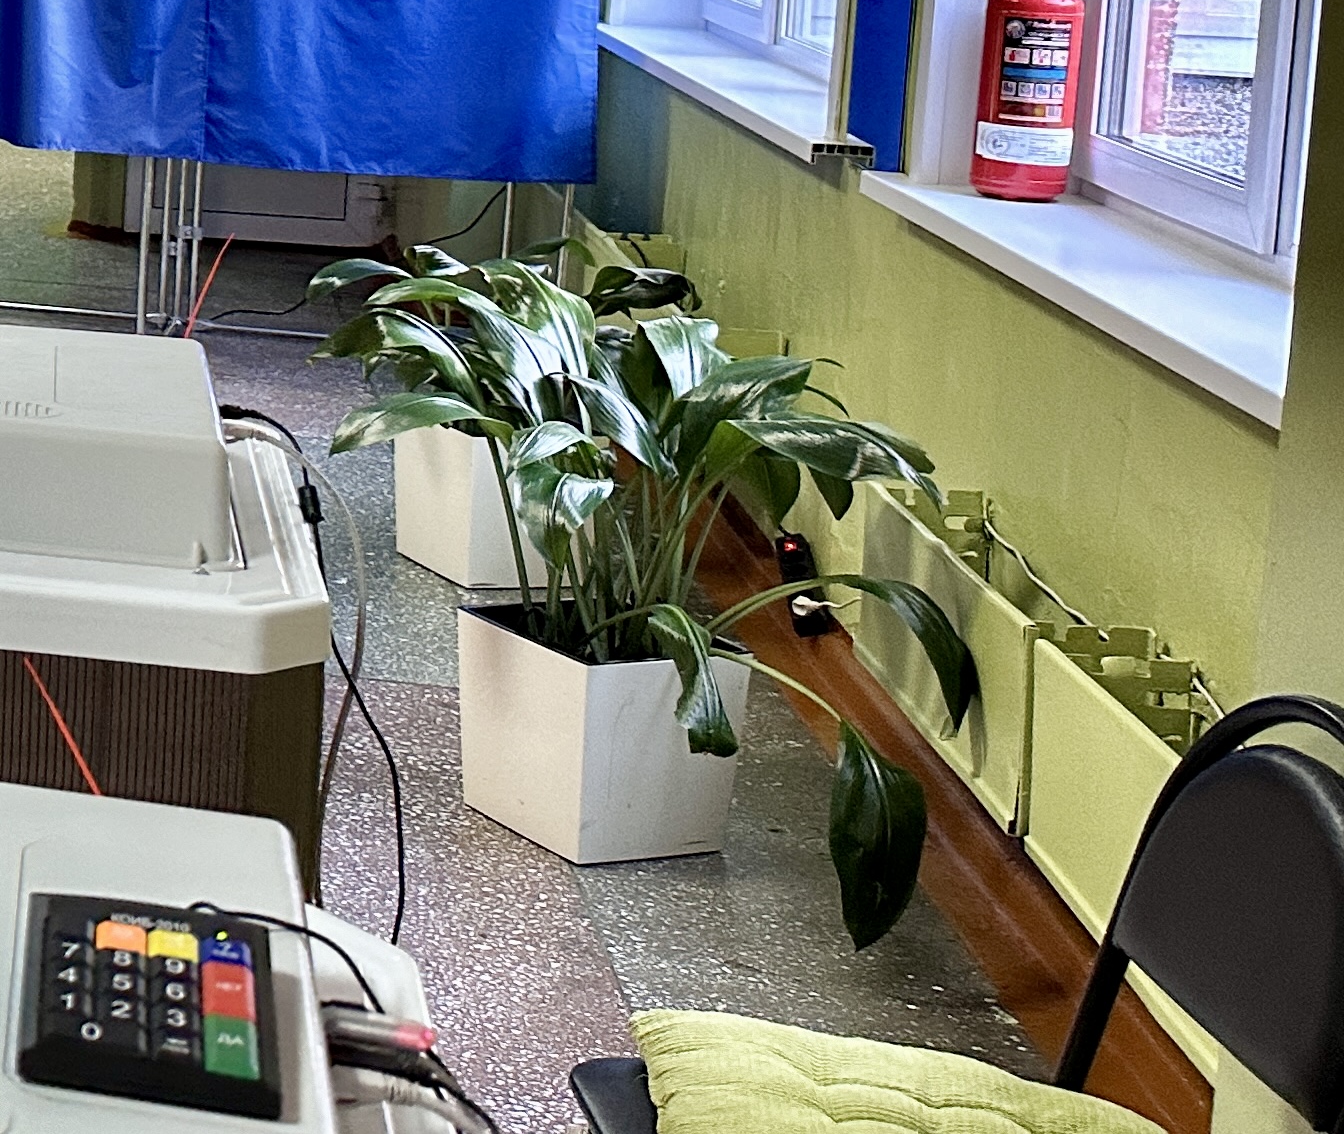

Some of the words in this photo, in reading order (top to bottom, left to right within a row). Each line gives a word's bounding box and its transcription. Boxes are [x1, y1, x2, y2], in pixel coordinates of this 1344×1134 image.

[62, 942, 81, 959] 7
[113, 951, 133, 967] 8
[165, 959, 186, 975] 9
[57, 967, 79, 983] 4
[112, 974, 133, 991] 5
[165, 983, 186, 1000] 6
[60, 993, 75, 1010] 1
[111, 1000, 132, 1019] 2
[167, 1009, 187, 1027] 3
[80, 1022, 103, 1041] 0
